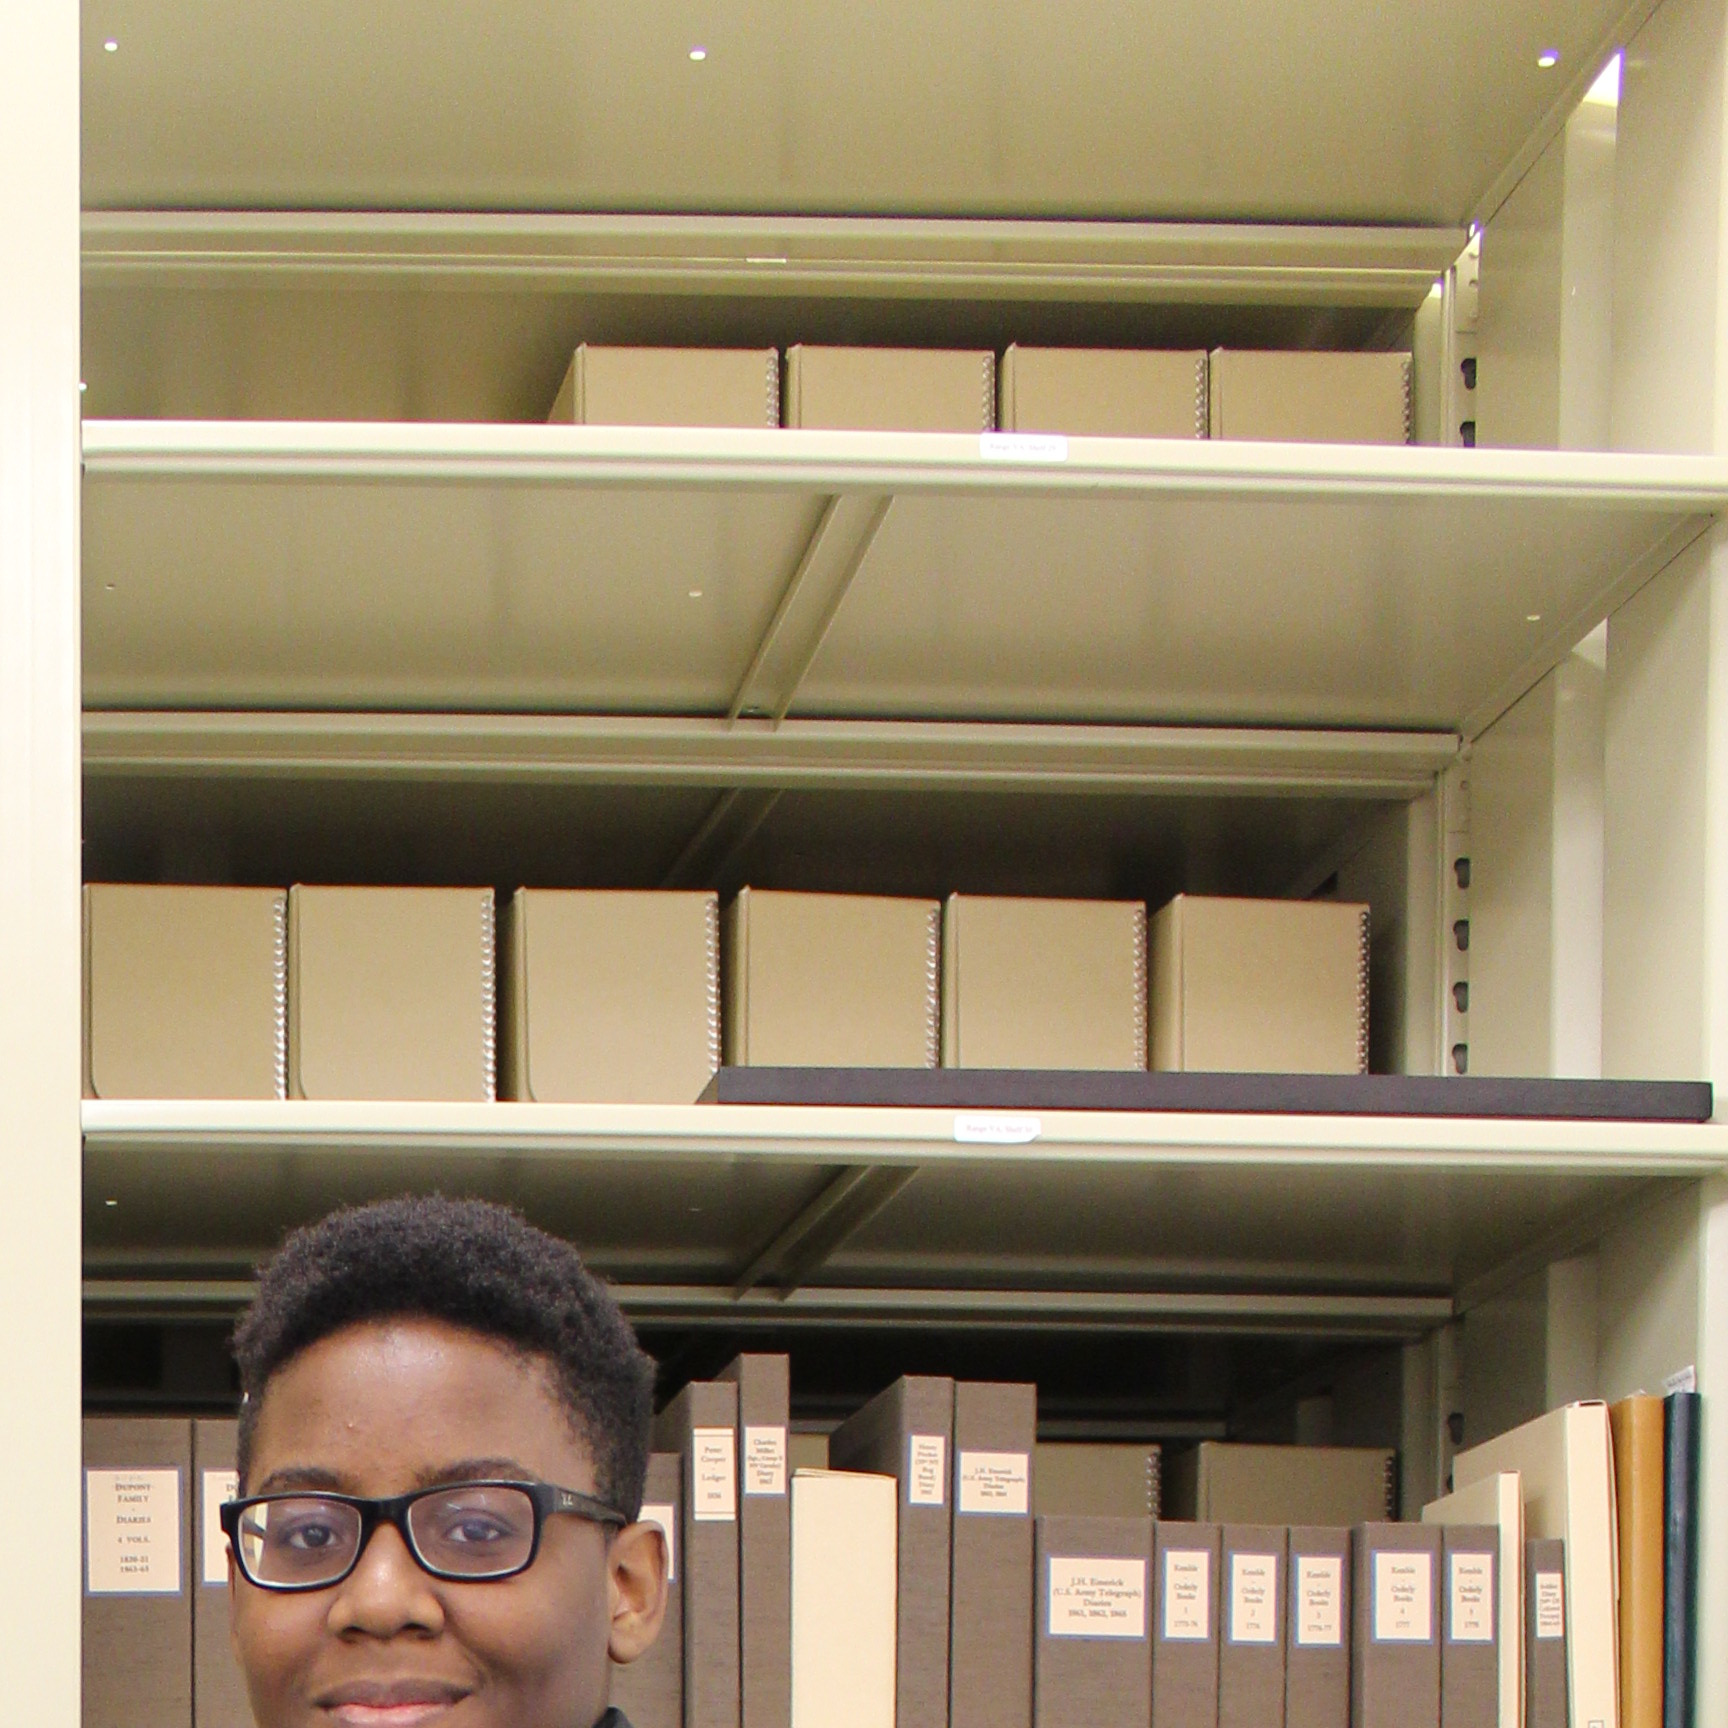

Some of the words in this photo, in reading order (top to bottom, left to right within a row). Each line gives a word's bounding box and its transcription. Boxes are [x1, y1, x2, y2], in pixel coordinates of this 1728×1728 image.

[117, 1495, 149, 1503] FAMILY
[116, 1516, 151, 1524] DIARIES
[1083, 1599, 1112, 1607] Diaries
